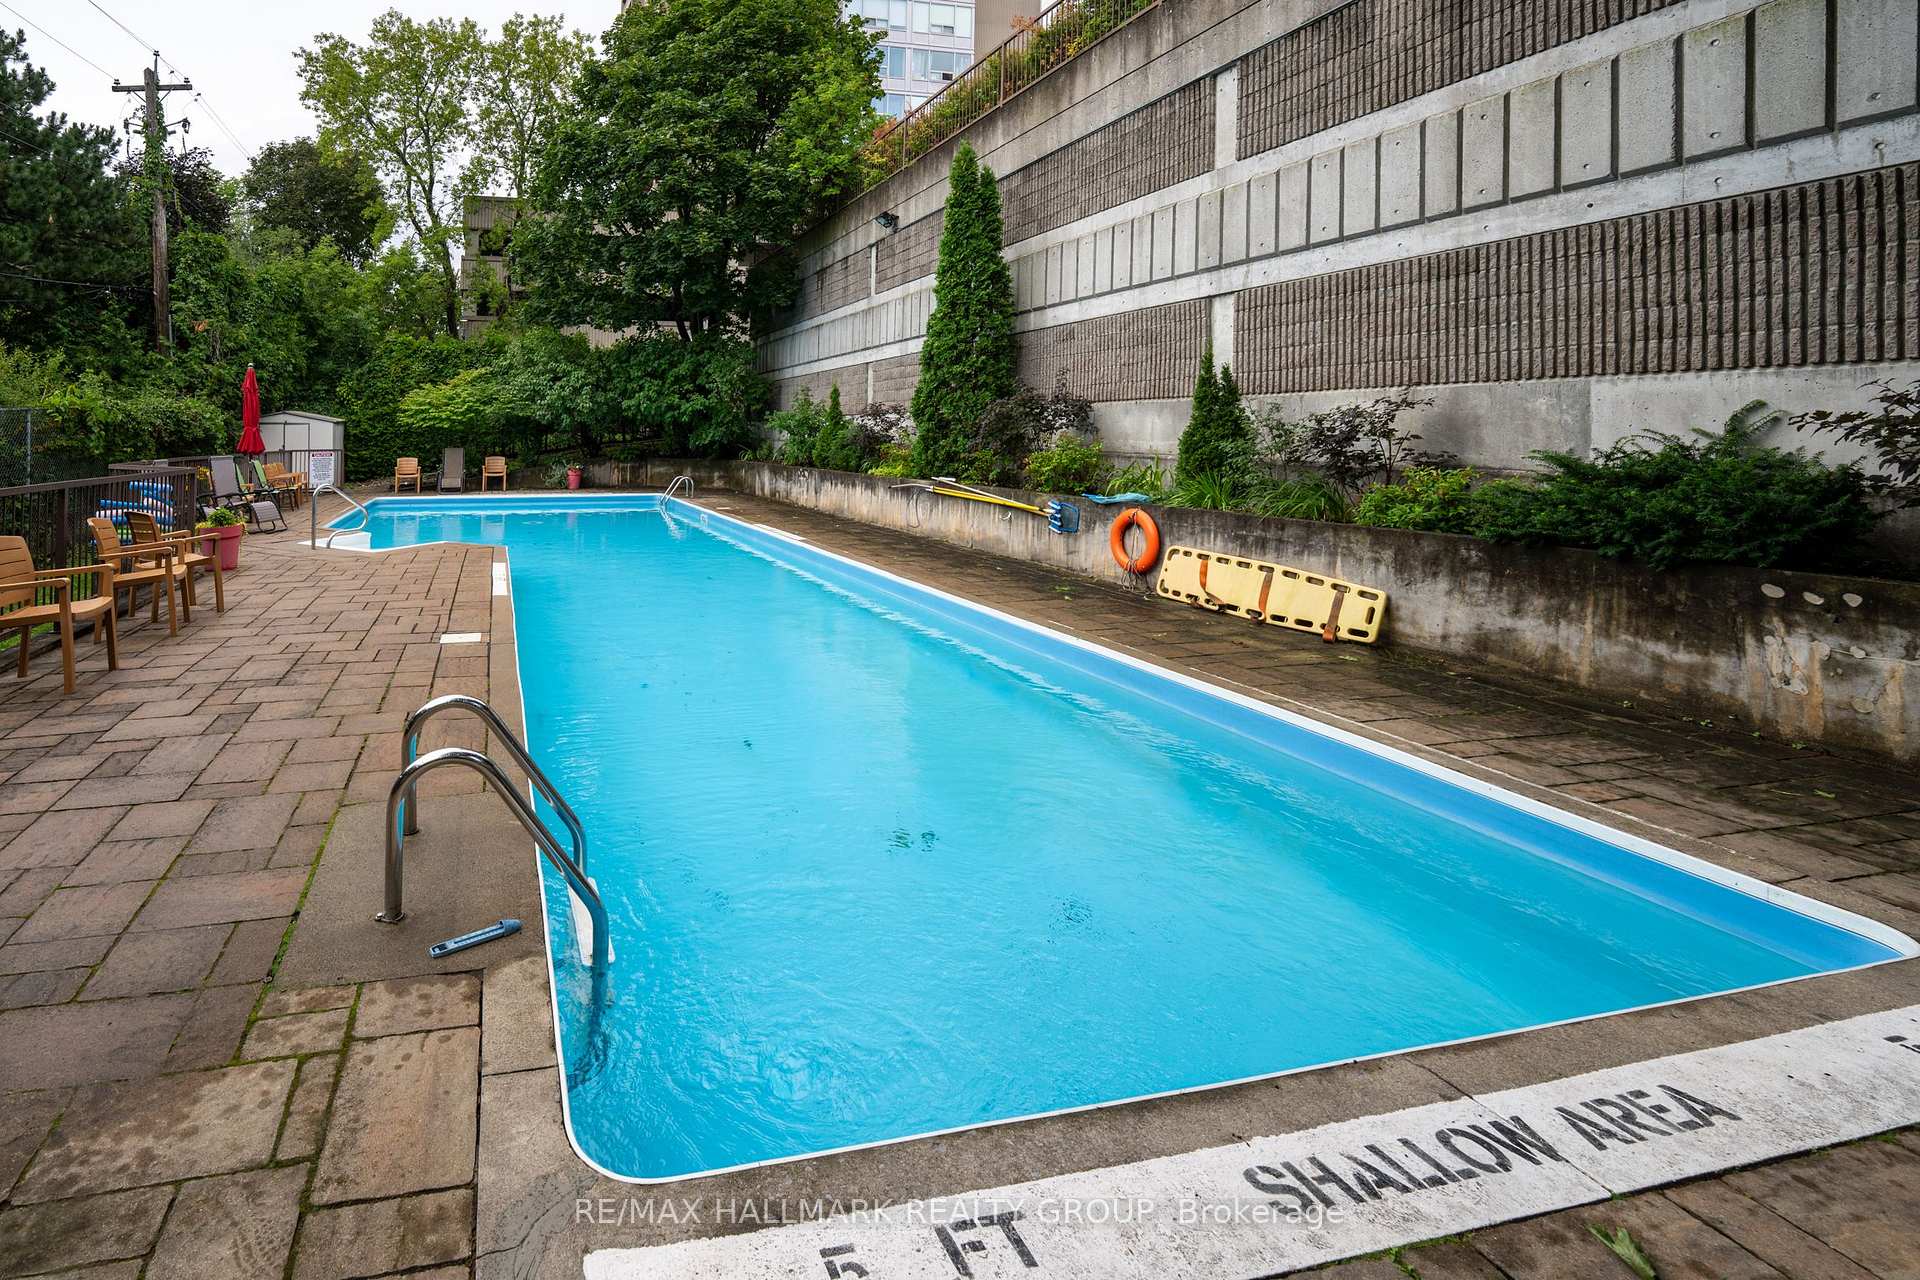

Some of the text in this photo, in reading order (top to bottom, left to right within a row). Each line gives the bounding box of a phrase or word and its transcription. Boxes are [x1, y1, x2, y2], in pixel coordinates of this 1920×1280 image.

[1242, 1083, 1743, 1217] SHALLOW AREA
[933, 1210, 1039, 1280] FT
